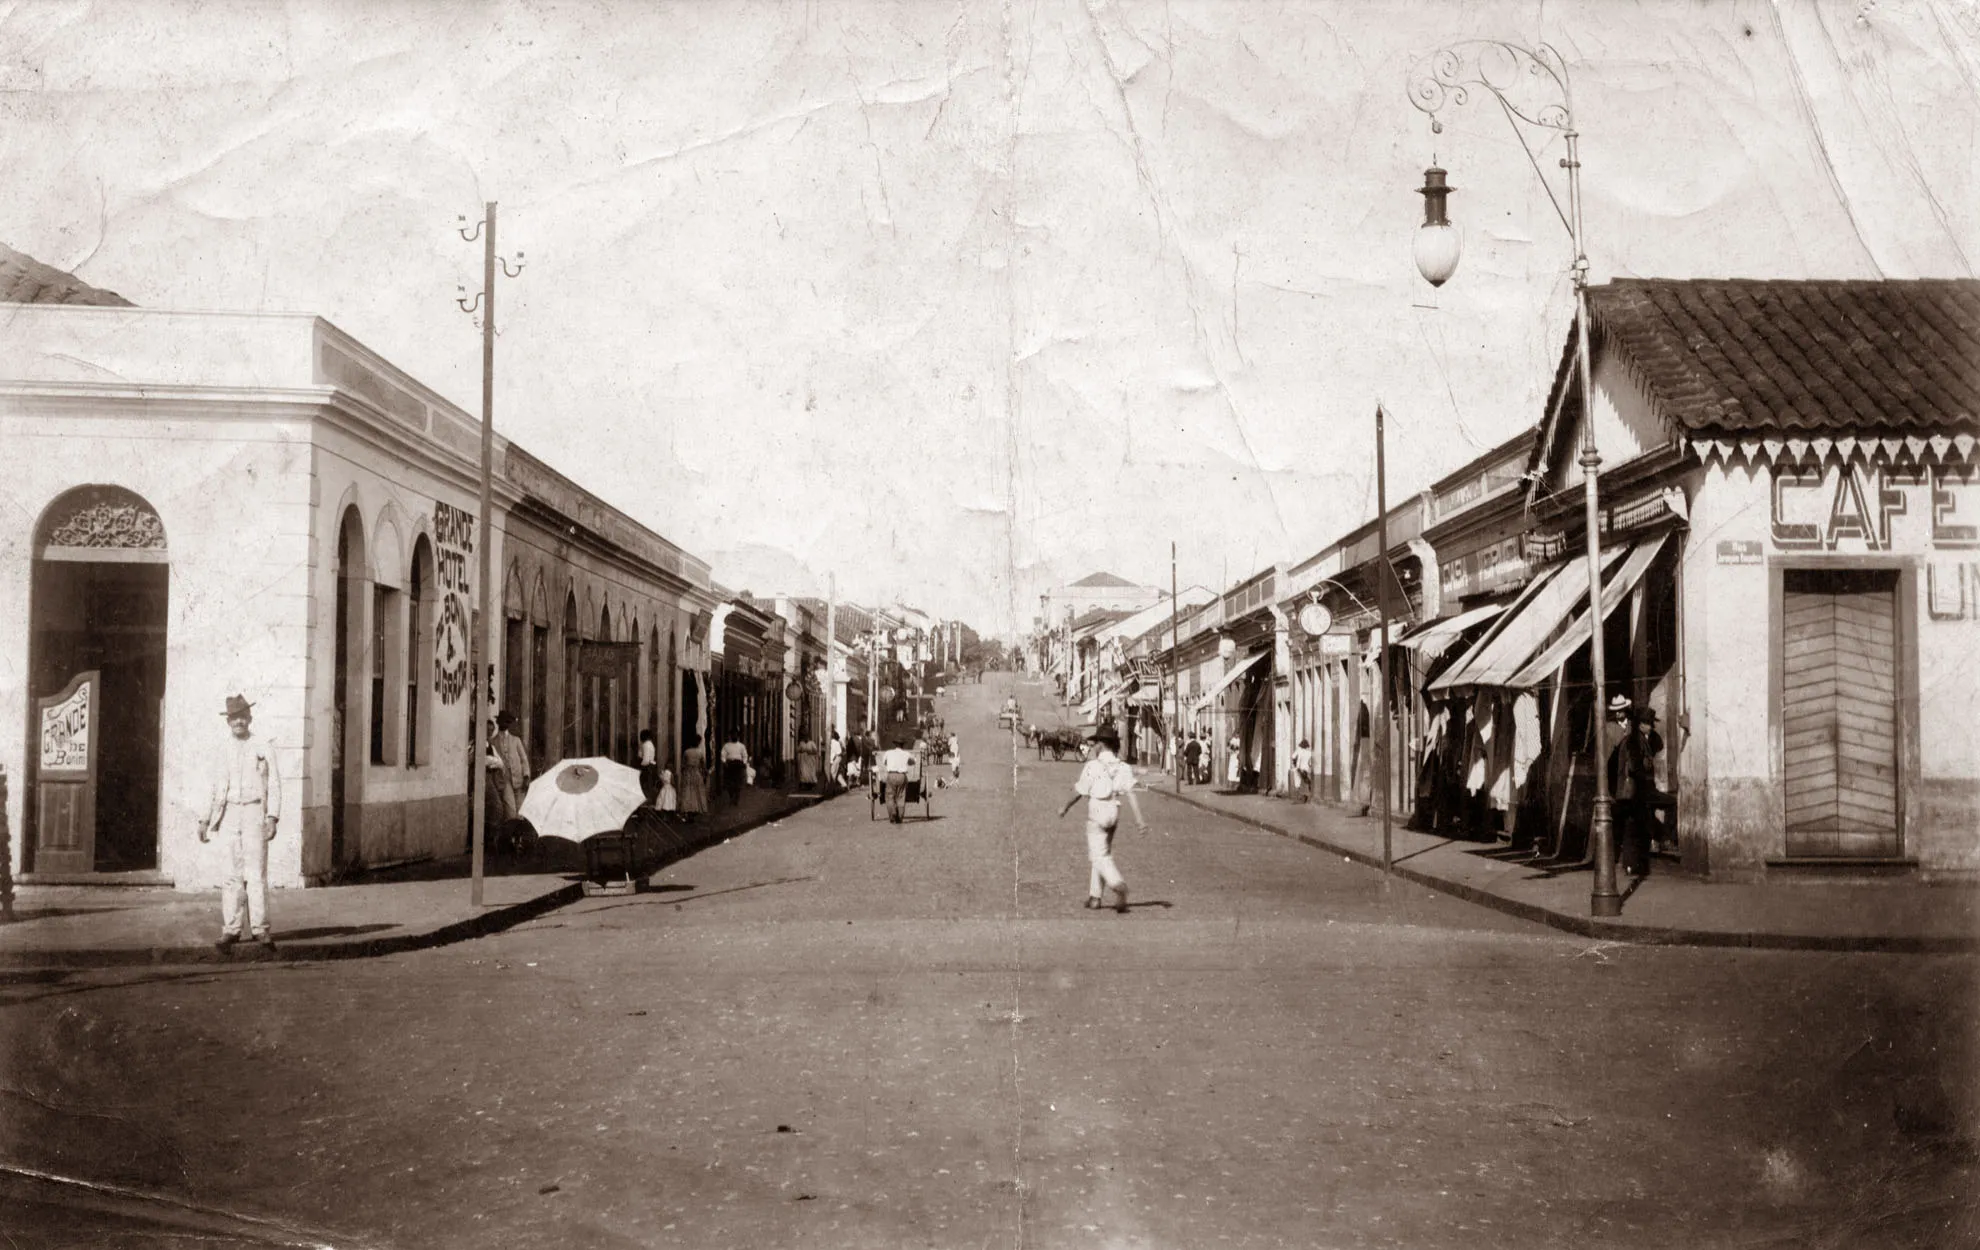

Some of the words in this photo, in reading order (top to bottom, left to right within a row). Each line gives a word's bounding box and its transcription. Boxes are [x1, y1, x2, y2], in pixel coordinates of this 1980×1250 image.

[435, 500, 473, 553] GRANDE
[436, 546, 469, 593] HOTEL
[44, 703, 87, 754] GRANDE
